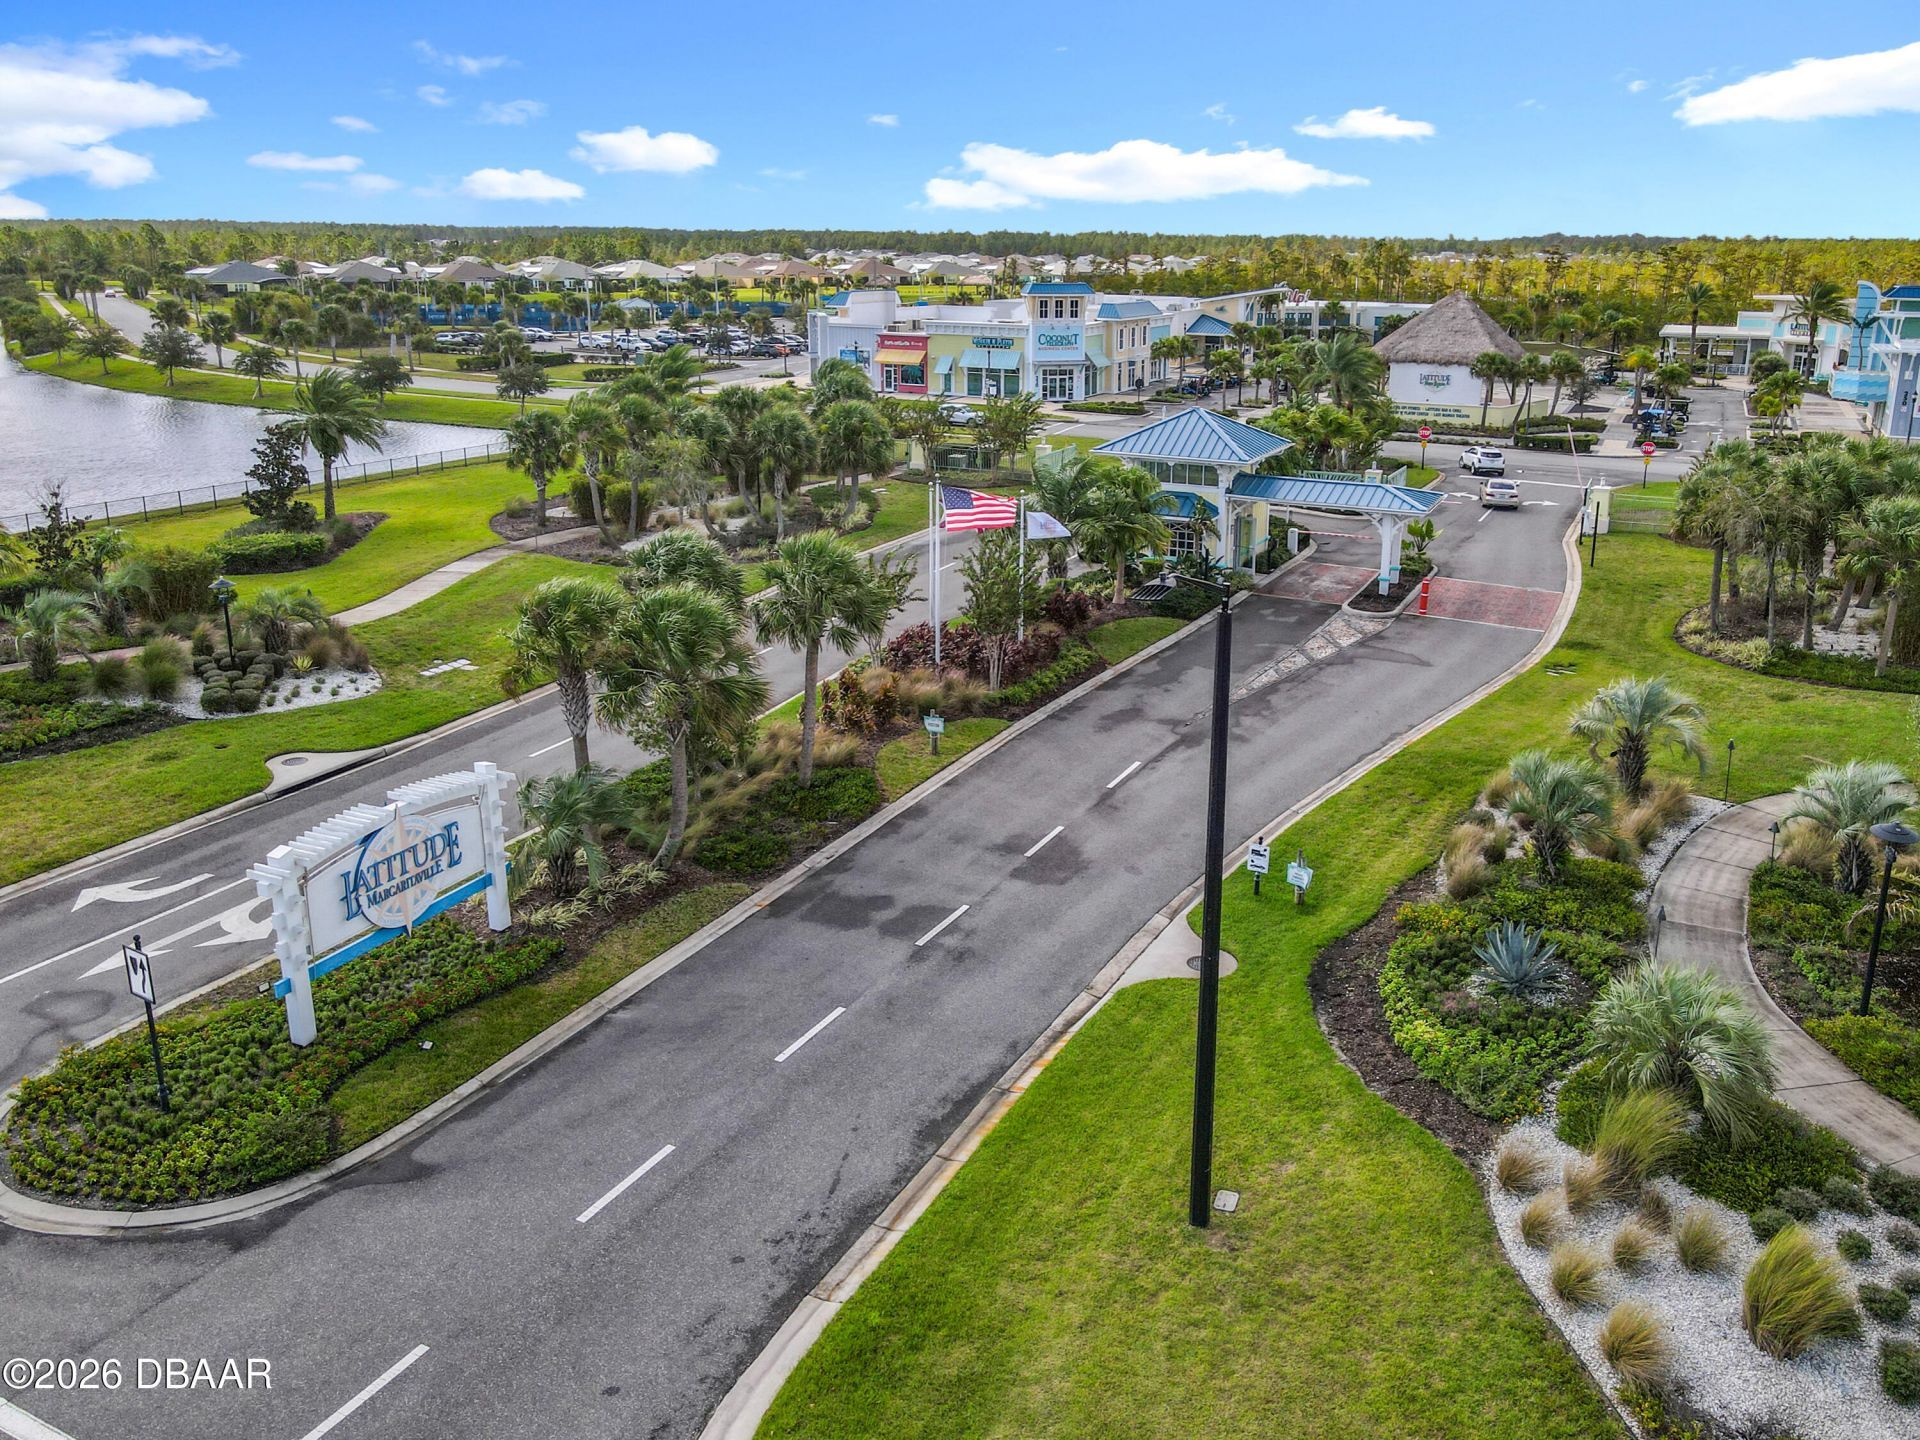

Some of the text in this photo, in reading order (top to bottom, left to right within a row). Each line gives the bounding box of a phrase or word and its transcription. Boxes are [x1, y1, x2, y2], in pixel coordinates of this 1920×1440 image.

[1038, 334, 1079, 345] COCONUT
[1419, 373, 1451, 385] LATITUDE
[339, 820, 463, 921] LATITUDE
[366, 858, 445, 909] MARGARITAVILLE
